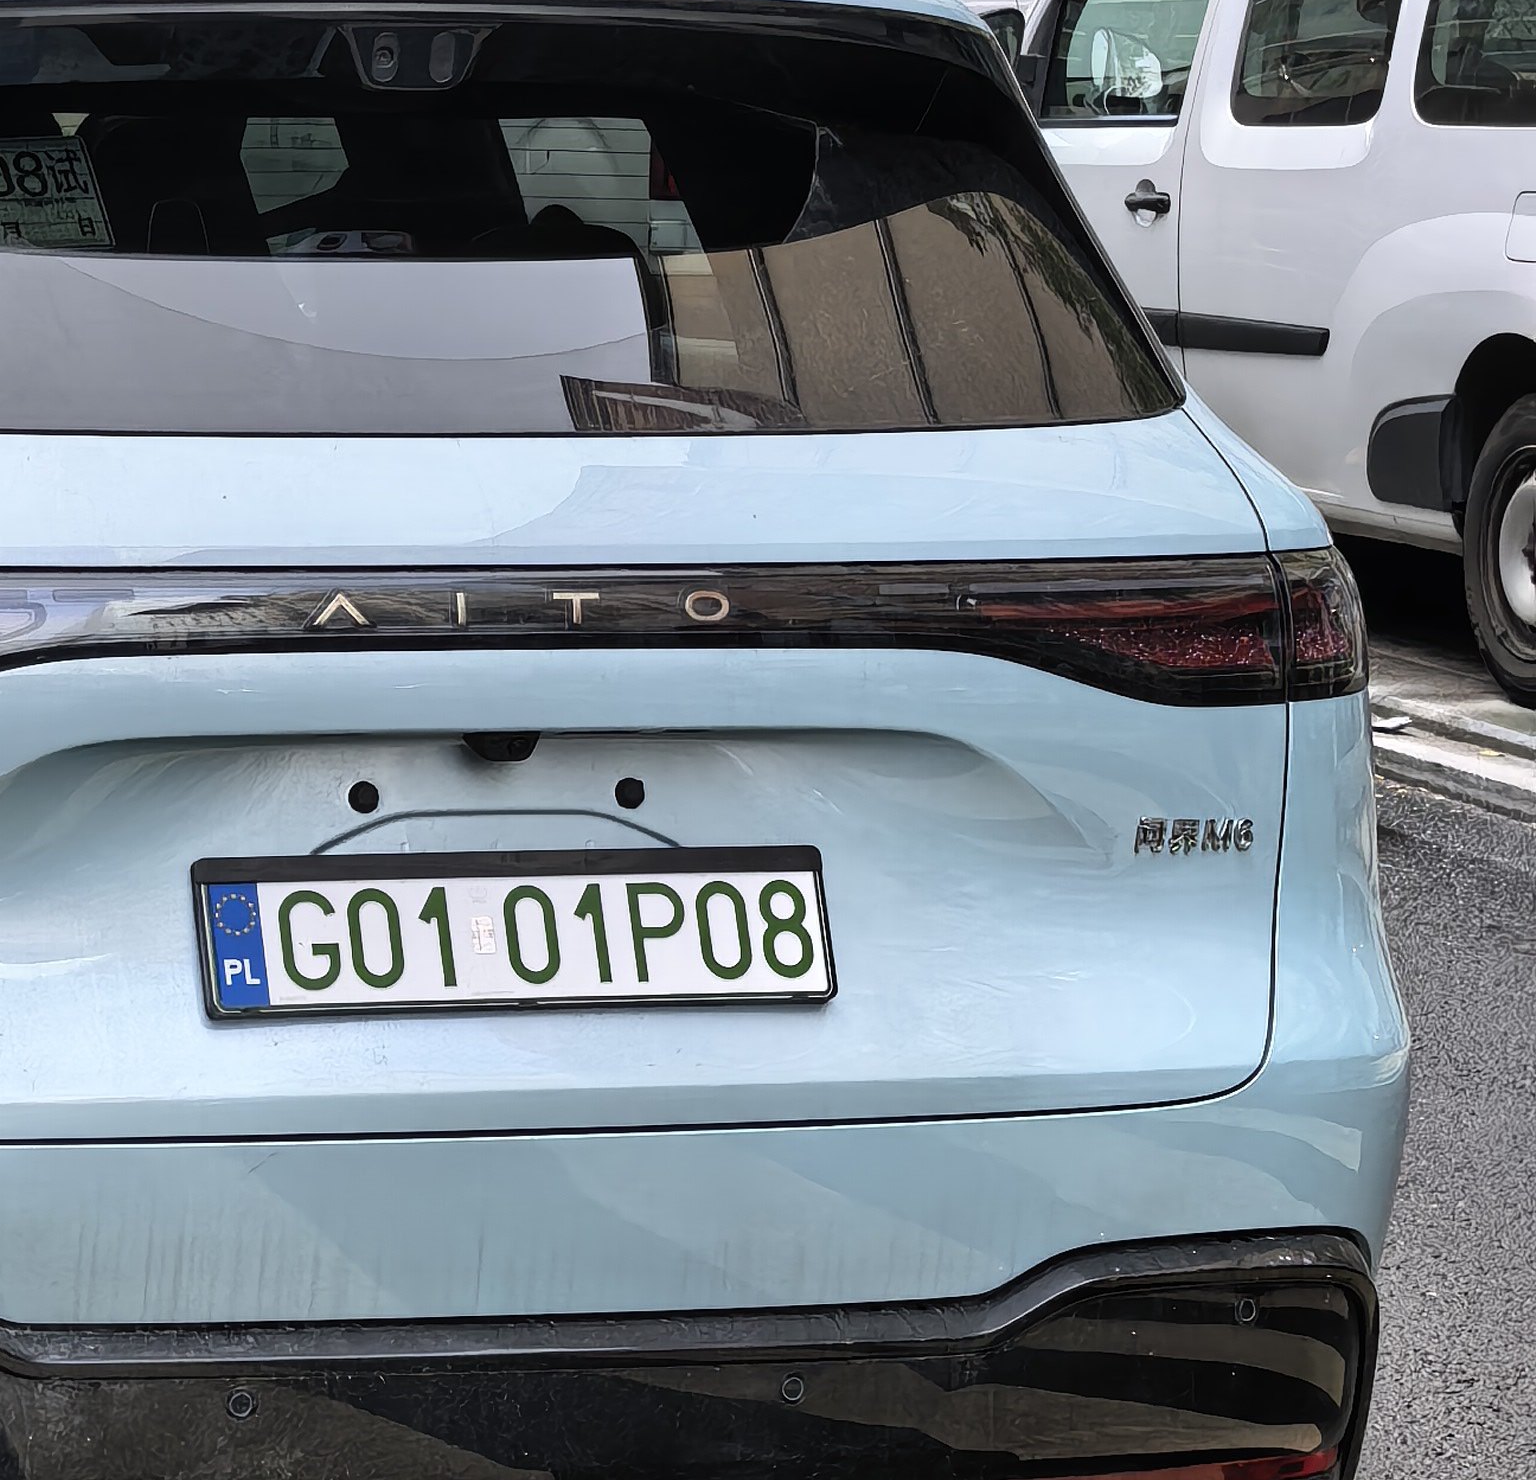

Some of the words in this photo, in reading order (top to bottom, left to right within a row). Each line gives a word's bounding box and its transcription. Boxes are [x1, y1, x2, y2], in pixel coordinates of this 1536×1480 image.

[312, 589, 731, 627] AITO
[223, 958, 261, 987] PL
[278, 886, 458, 991] G01
[504, 879, 814, 985] 01P08
